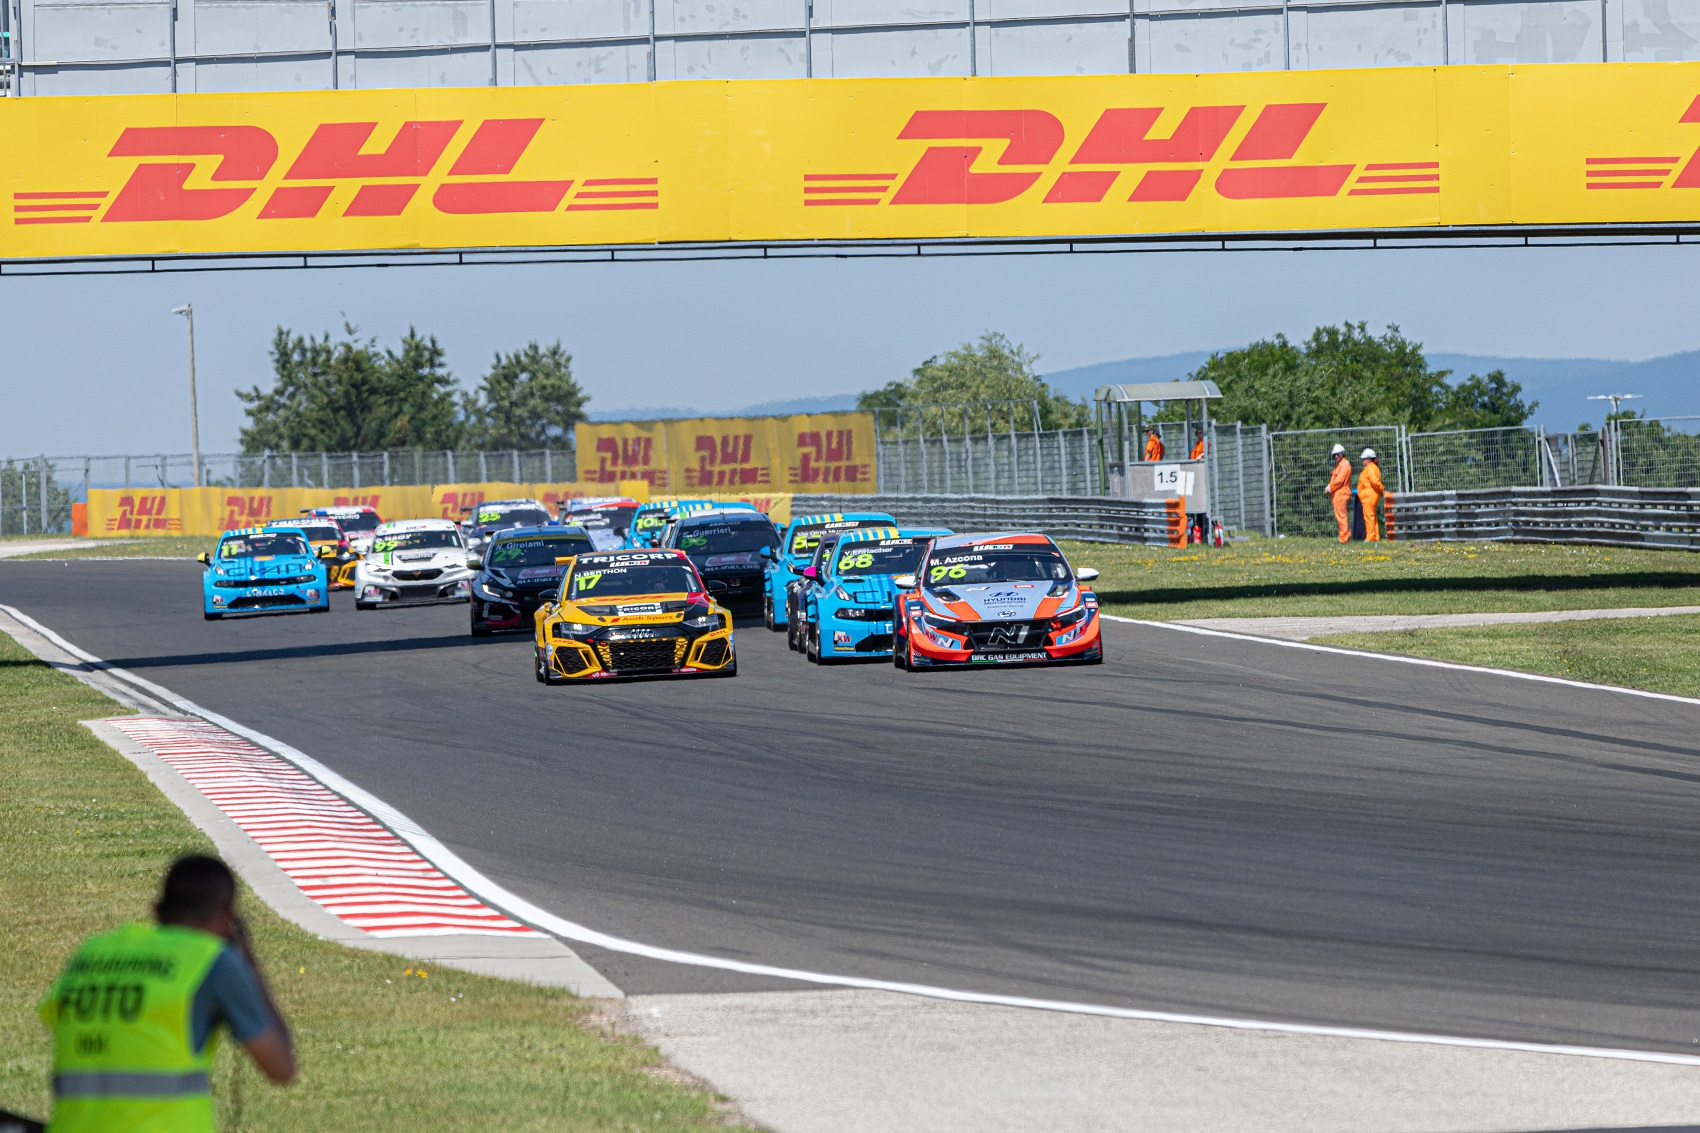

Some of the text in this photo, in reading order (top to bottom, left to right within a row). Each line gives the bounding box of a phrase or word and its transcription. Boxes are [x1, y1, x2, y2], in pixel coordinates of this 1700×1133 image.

[889, 103, 1355, 204] DHL
[100, 118, 574, 222] DHL
[1157, 471, 1178, 483] 1.5
[116, 495, 168, 530] DHL
[373, 541, 398, 553] 99
[494, 549, 521, 562] 29
[579, 553, 678, 564] TRICORP
[838, 553, 873, 571] 68
[945, 554, 983, 563] Azcona
[930, 563, 967, 581] 96
[574, 574, 602, 591] 17
[1005, 651, 1047, 659] EQUIPMENT
[56, 982, 146, 1025] FOTO
